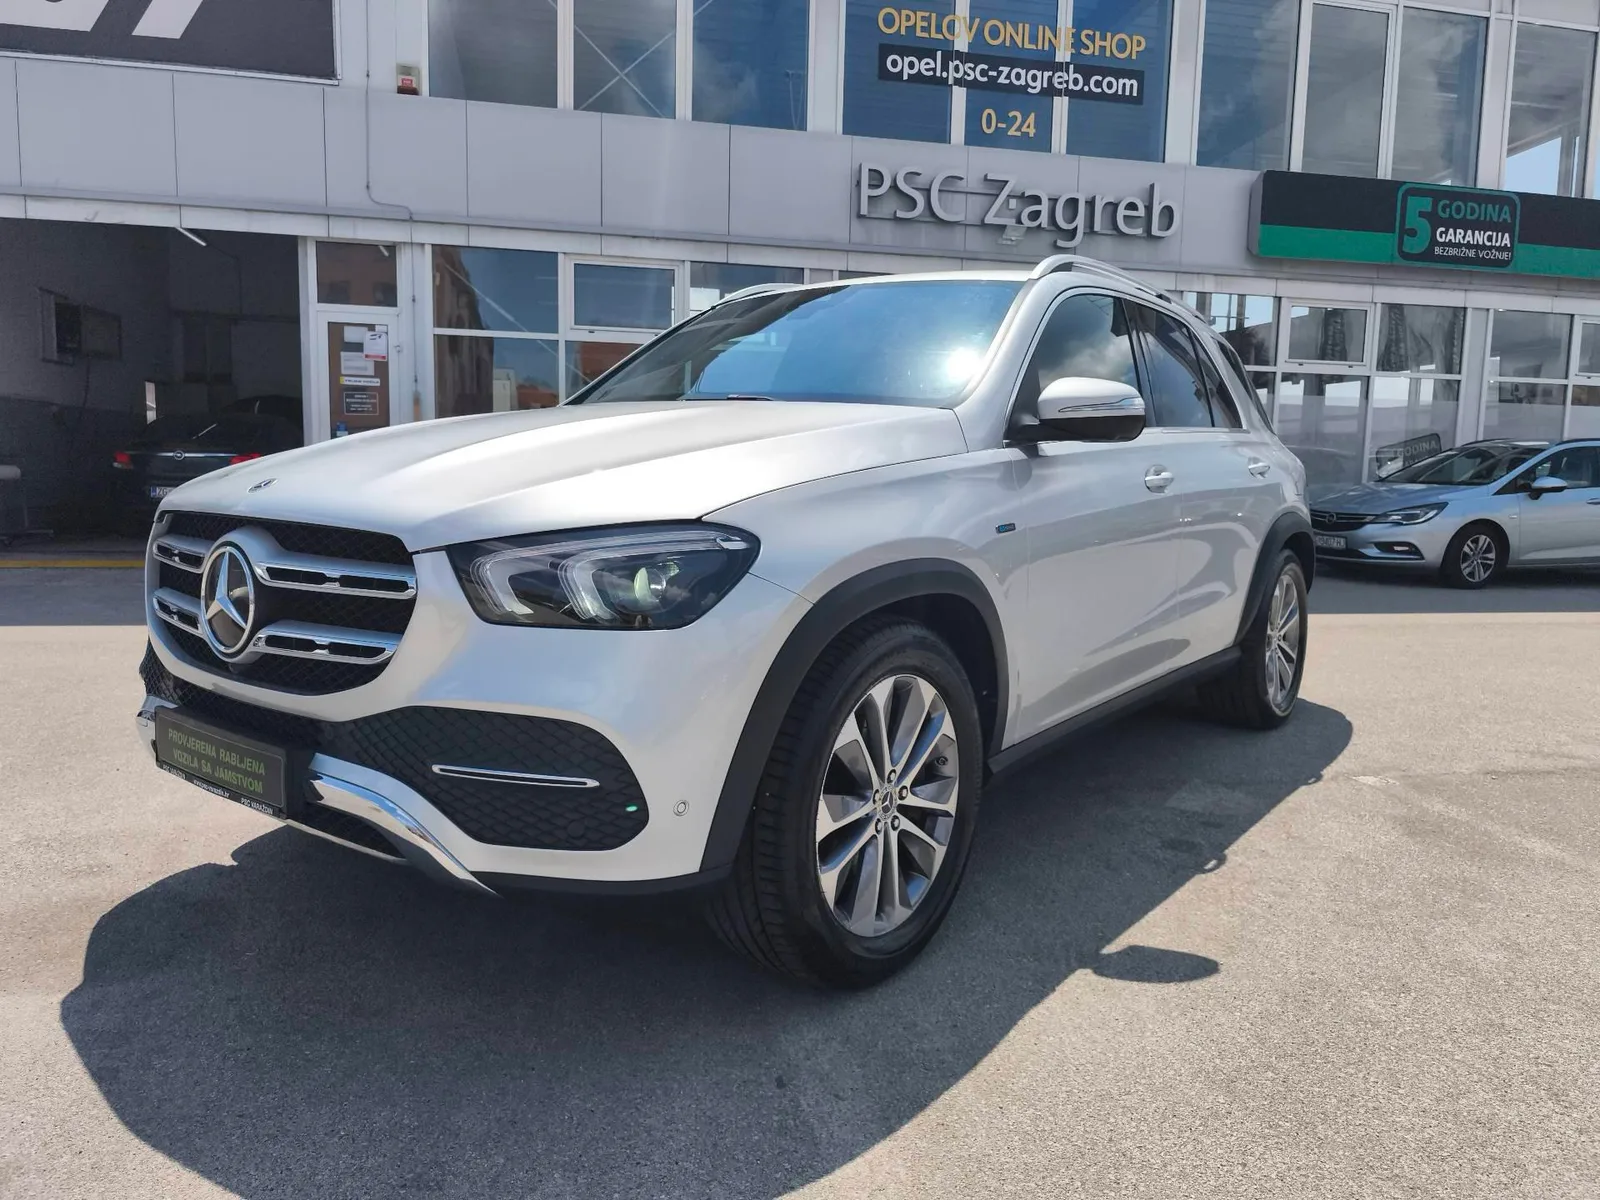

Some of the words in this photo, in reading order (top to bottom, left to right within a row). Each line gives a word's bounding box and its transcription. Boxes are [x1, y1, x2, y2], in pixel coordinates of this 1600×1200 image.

[877, 7, 981, 43] OPELOV
[983, 19, 1077, 54] ONLINE
[1080, 29, 1146, 60] SHOP
[886, 50, 1138, 97] opel.psc-zagreb.com
[981, 108, 1036, 138] 0-24
[857, 162, 965, 223] PSC
[983, 172, 1180, 249] Zagreb
[1402, 195, 1433, 254] 5
[1437, 199, 1512, 223] GODINA
[1434, 246, 1477, 258] BEZBRIŽNE
[1477, 249, 1512, 261] VOŽNJE!
[1436, 226, 1511, 248] GARANCIJA
[168, 727, 217, 758] PROVJERENA
[219, 748, 266, 776] RABLJENA
[172, 749, 199, 770] VOZILA
[201, 759, 212, 774] SA
[214, 766, 263, 794] JAMSTVOM
